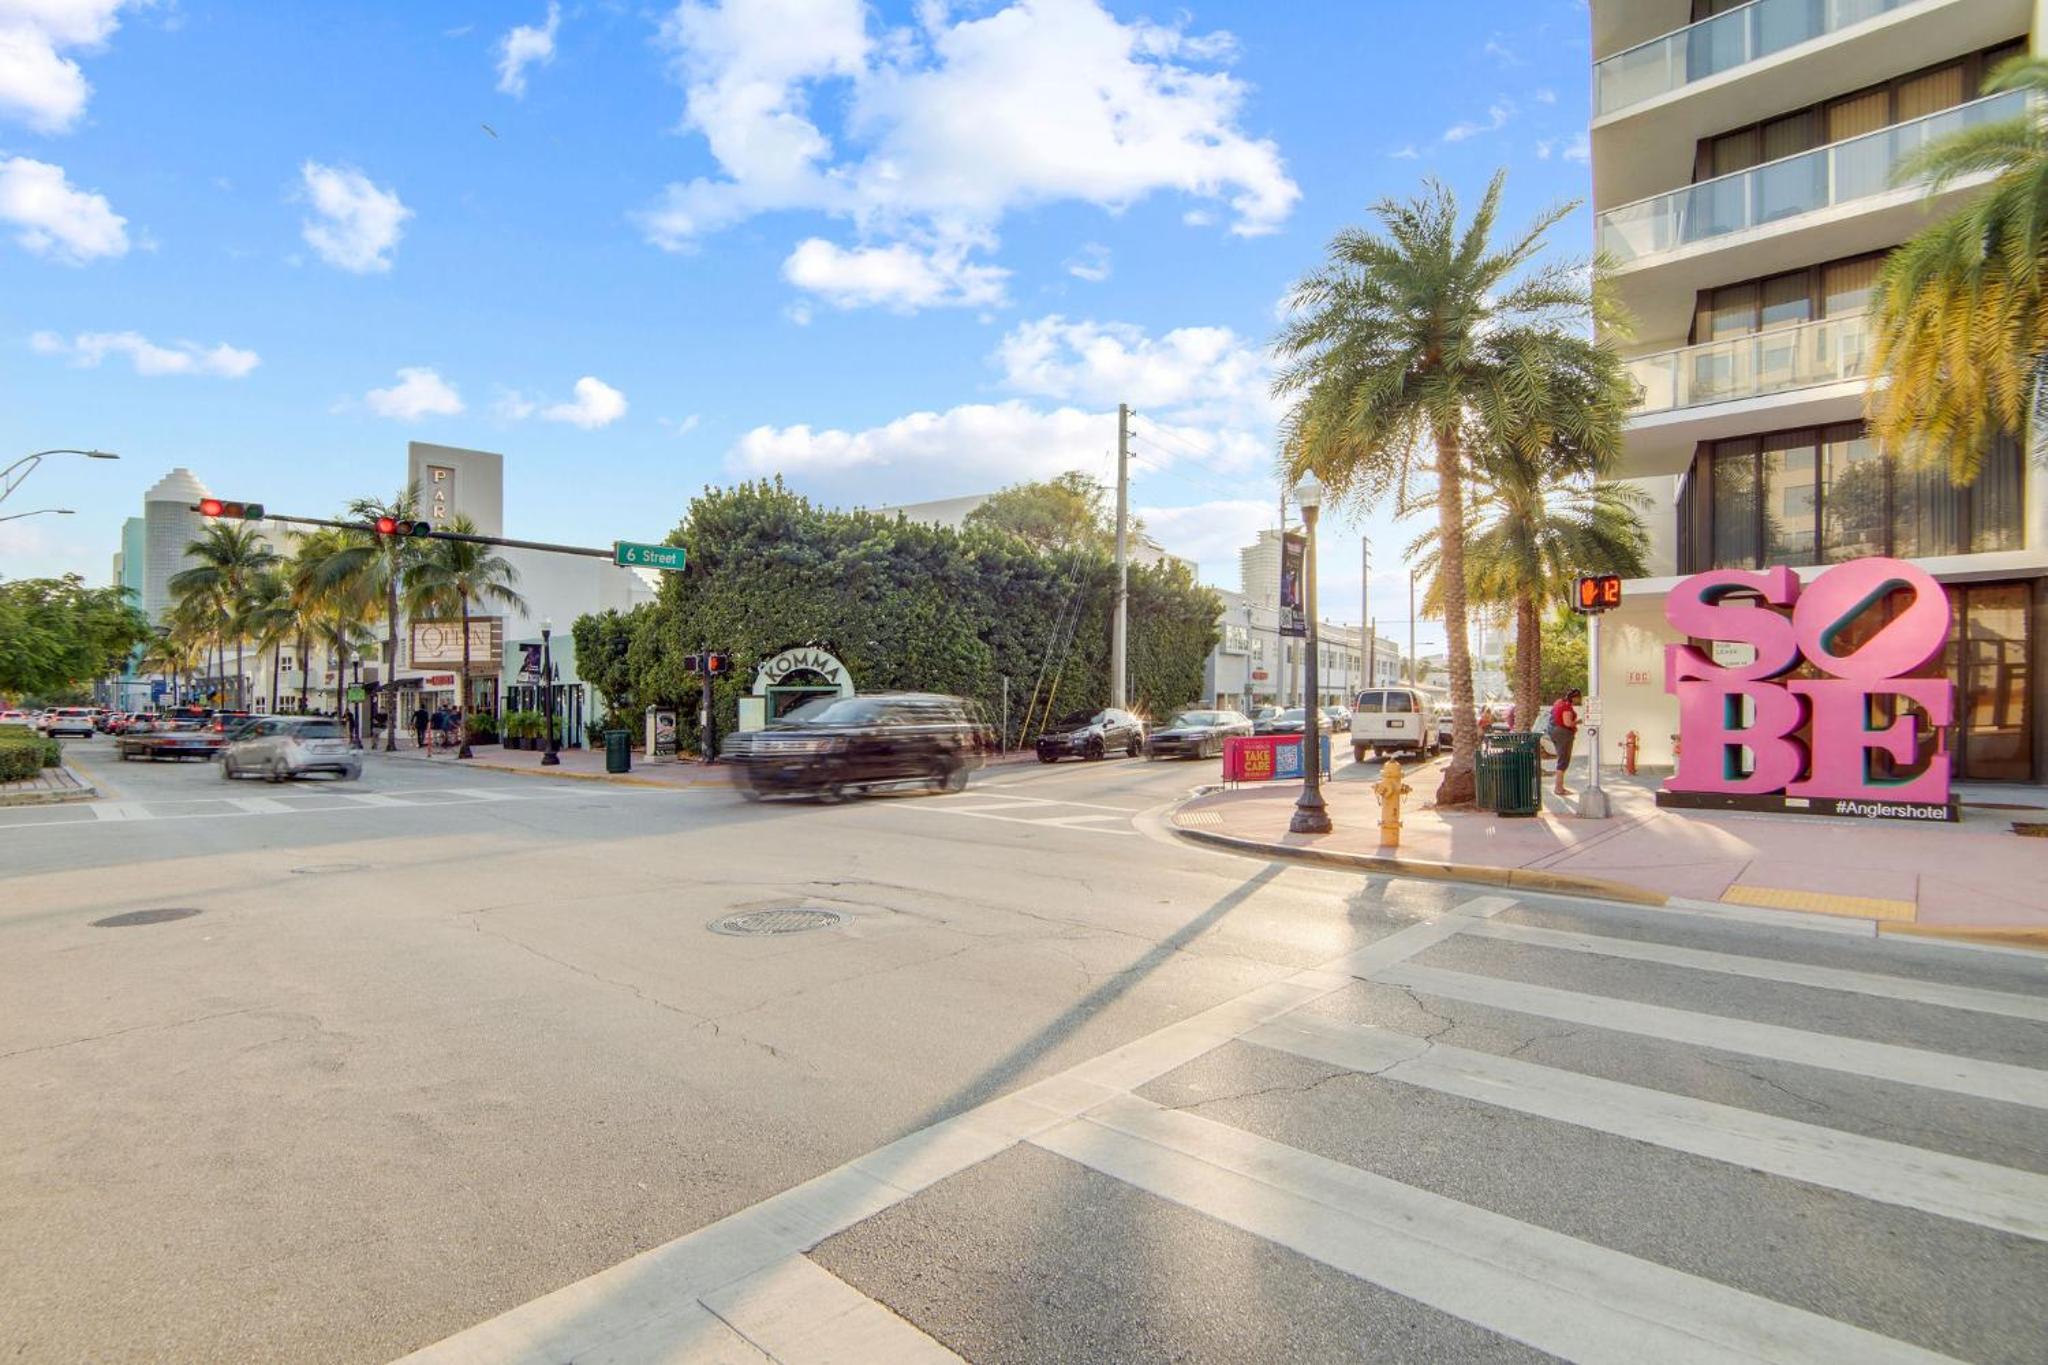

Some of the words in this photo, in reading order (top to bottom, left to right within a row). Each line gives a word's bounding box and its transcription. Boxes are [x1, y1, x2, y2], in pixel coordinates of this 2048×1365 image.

[627, 548, 636, 561] 6
[643, 550, 677, 564] Street
[1605, 580, 1618, 602] 12
[421, 627, 485, 657] QUEN
[1244, 750, 1271, 761] TAKE
[1244, 761, 1271, 771] CARE
[1835, 800, 1948, 820] #Anglershotel
